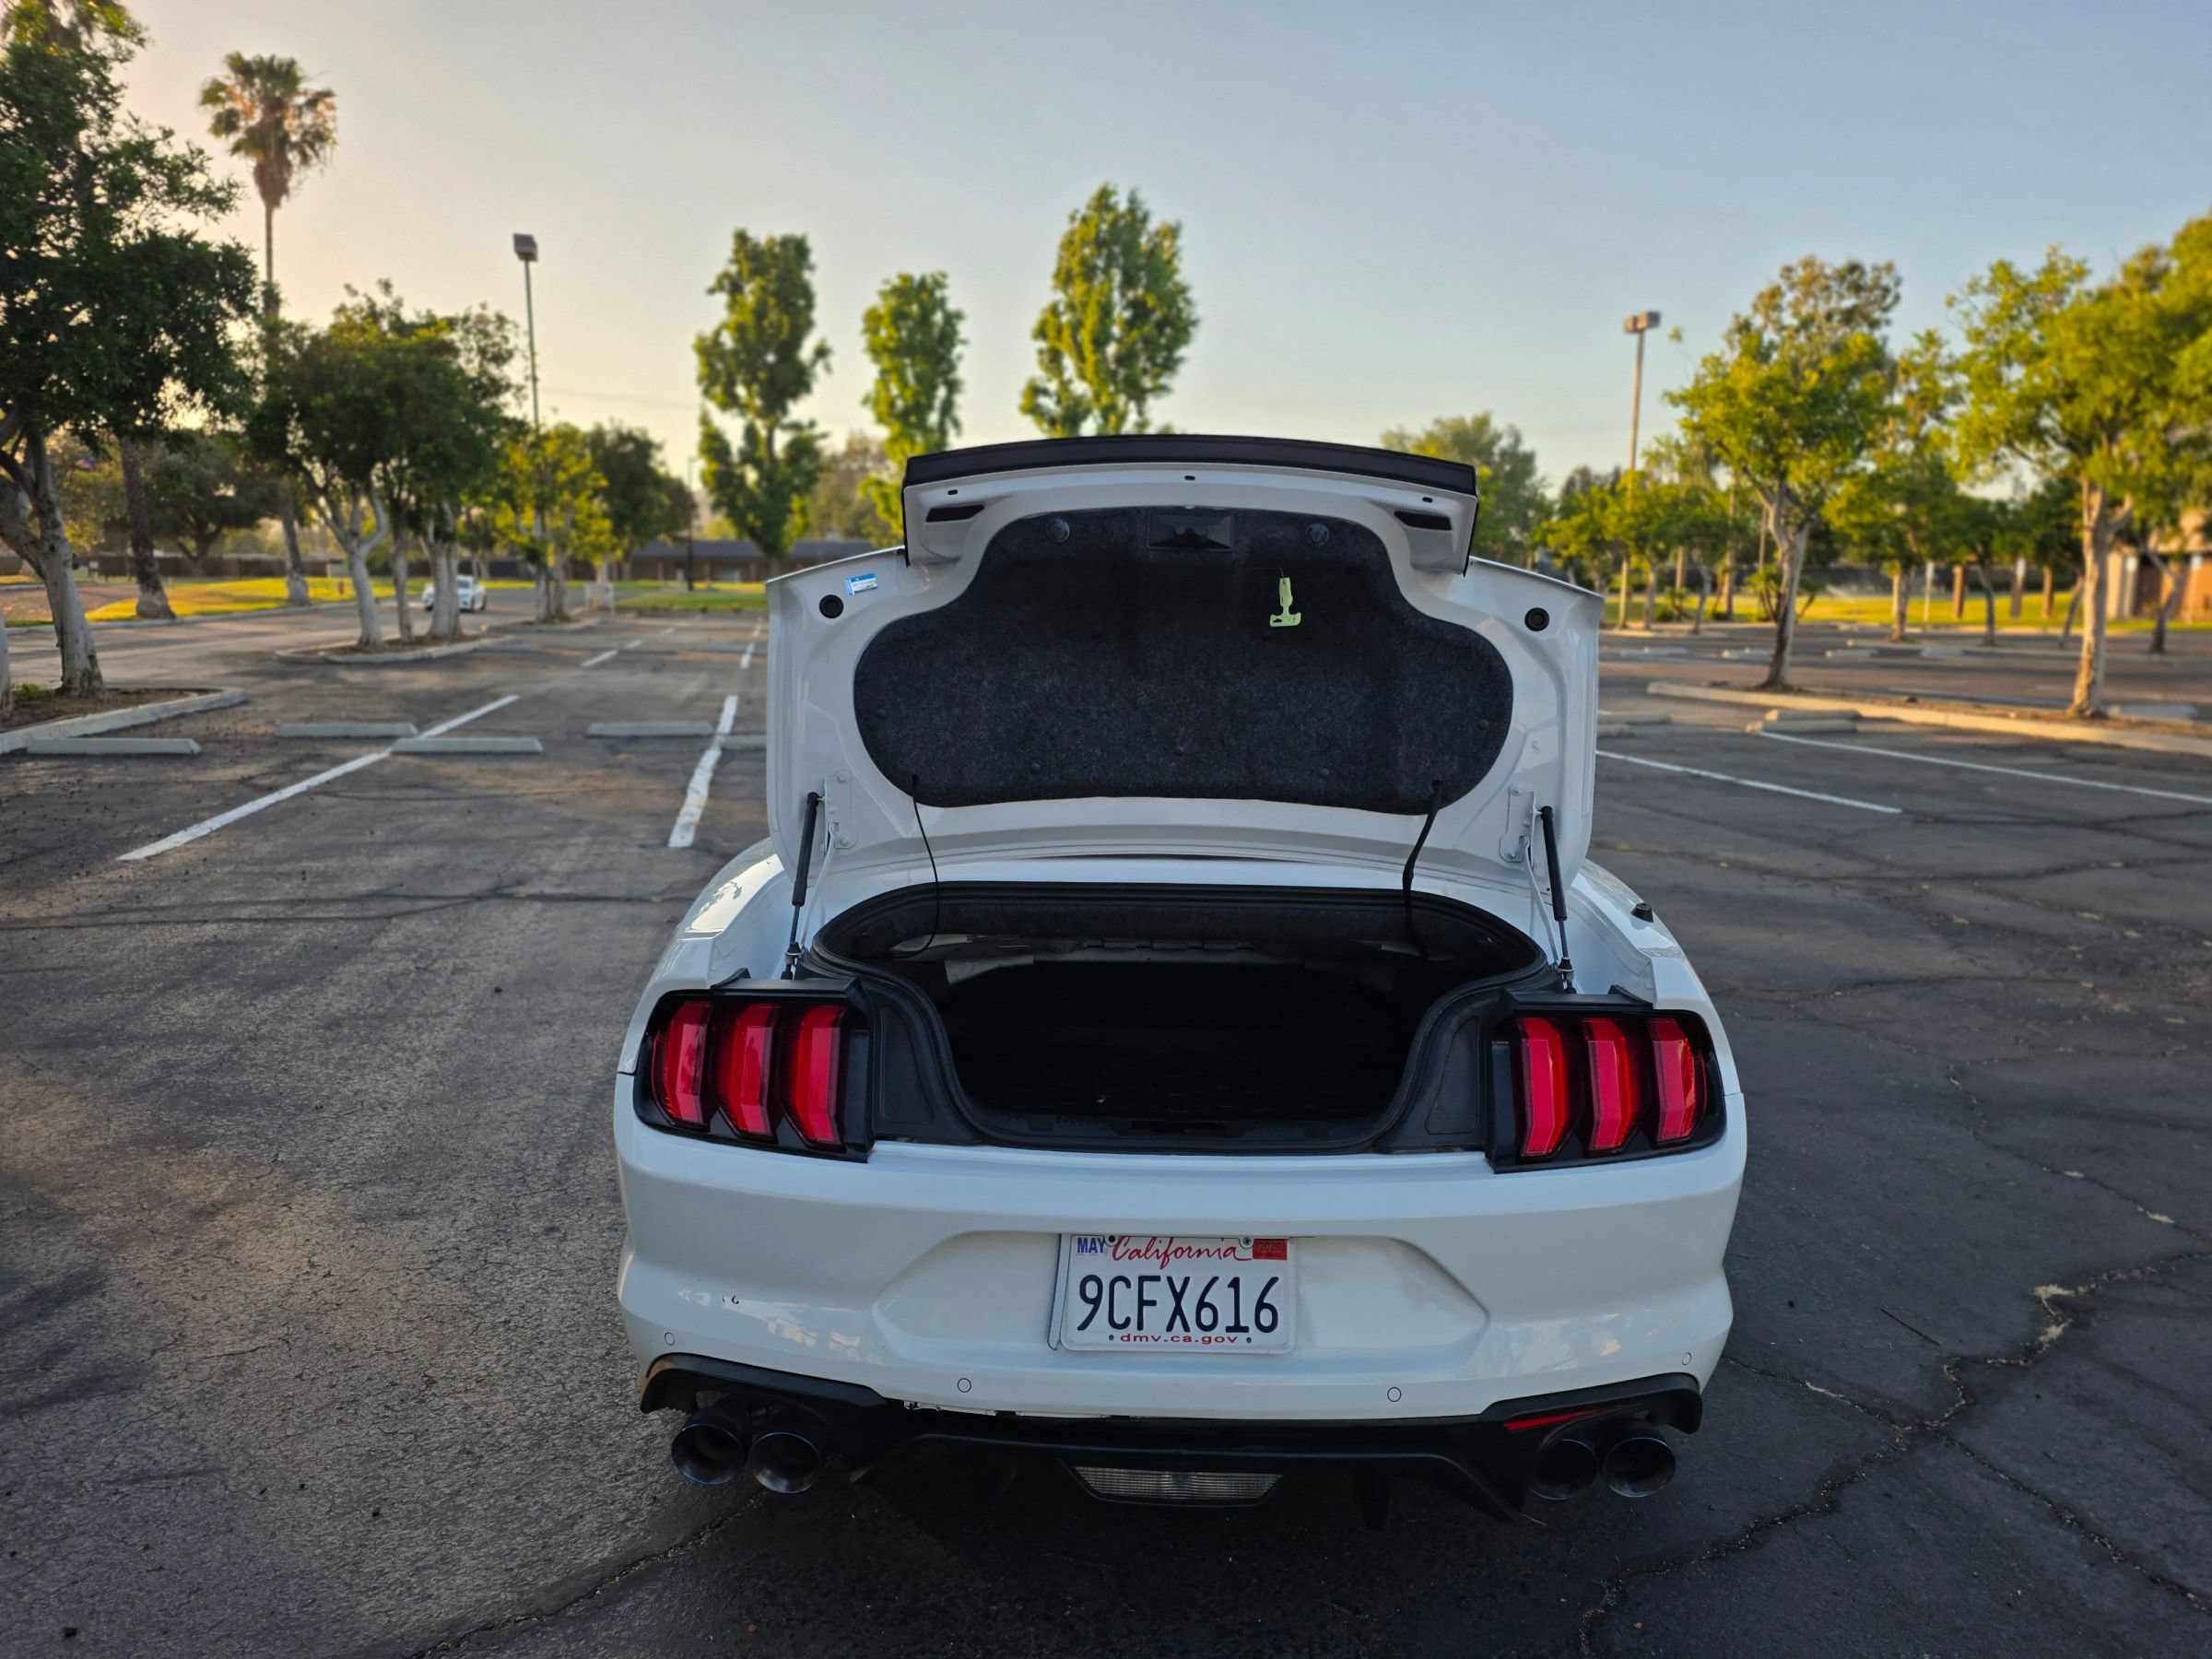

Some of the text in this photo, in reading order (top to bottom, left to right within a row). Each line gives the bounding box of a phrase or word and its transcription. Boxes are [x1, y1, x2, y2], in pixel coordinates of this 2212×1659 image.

[1077, 1237, 1105, 1253] MAY
[1112, 1236, 1253, 1270] California
[1077, 1275, 1279, 1333] 9CFX616
[1120, 1335, 1238, 1345] dmv.ca.gov
